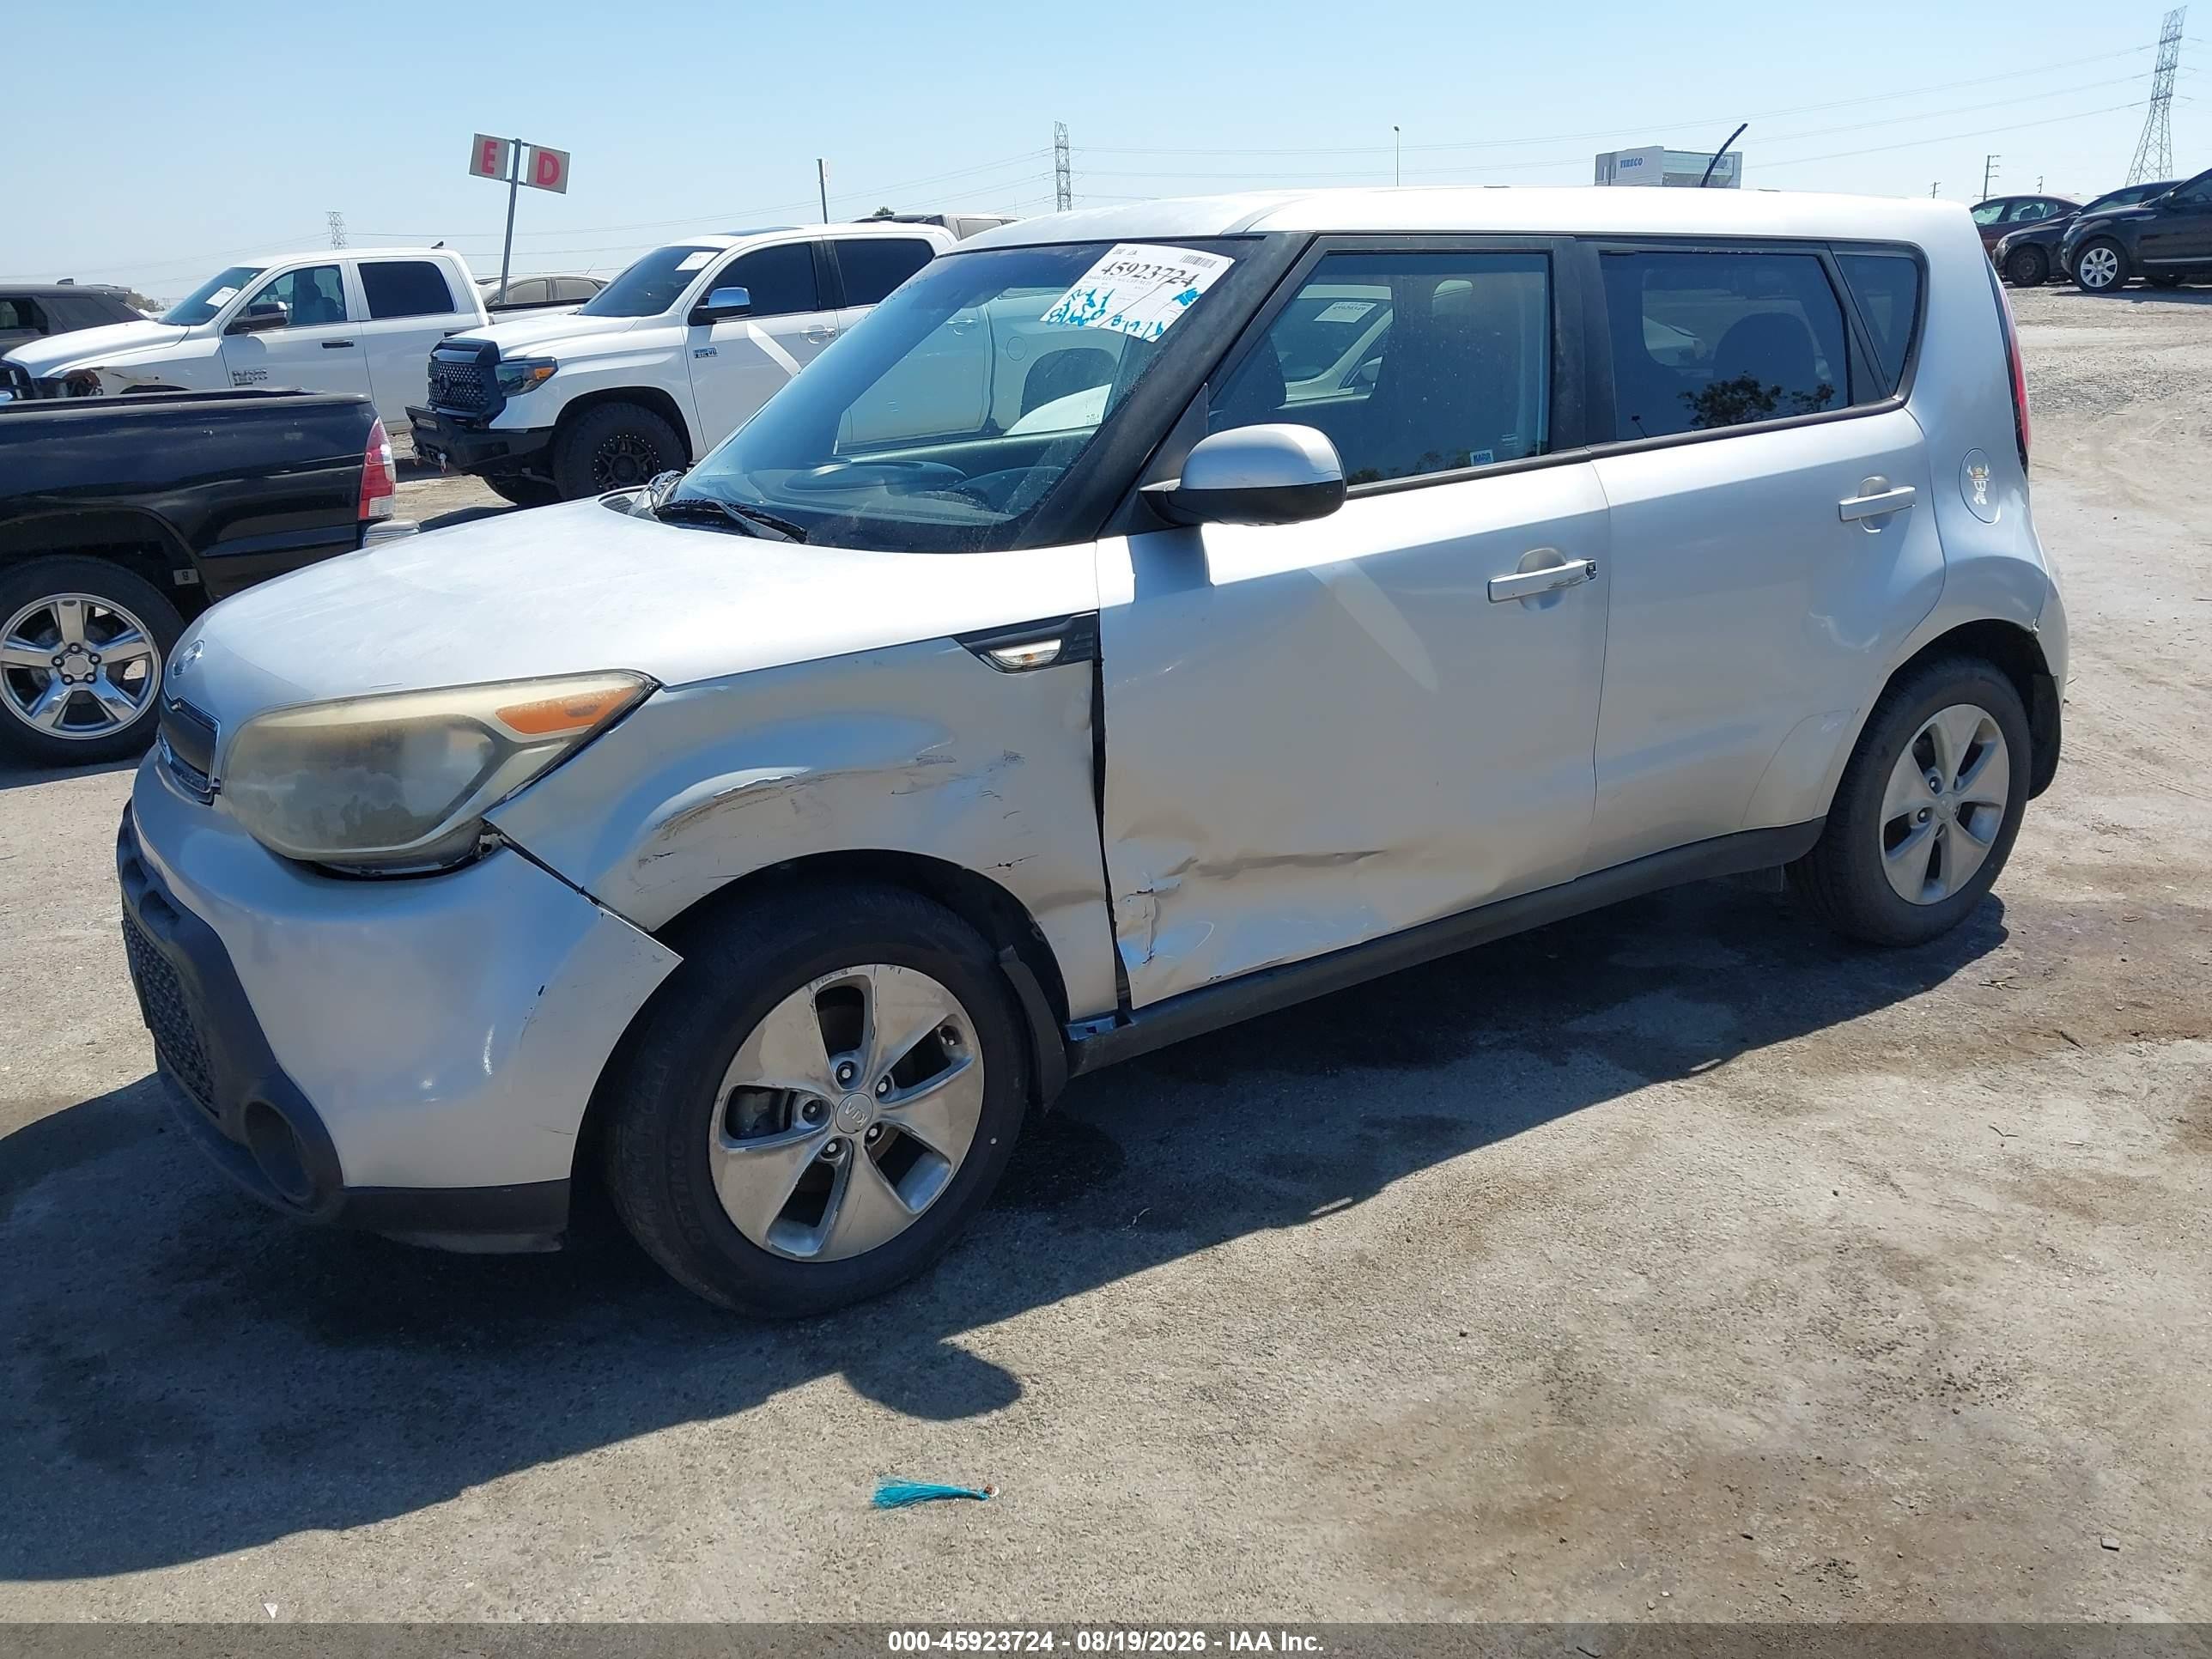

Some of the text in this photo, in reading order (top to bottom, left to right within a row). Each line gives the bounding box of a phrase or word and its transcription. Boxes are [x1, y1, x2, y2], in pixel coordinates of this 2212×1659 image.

[482, 141, 498, 174] E
[536, 151, 561, 185] D
[1101, 260, 1200, 288] 45923724
[844, 1101, 868, 1127] KIA
